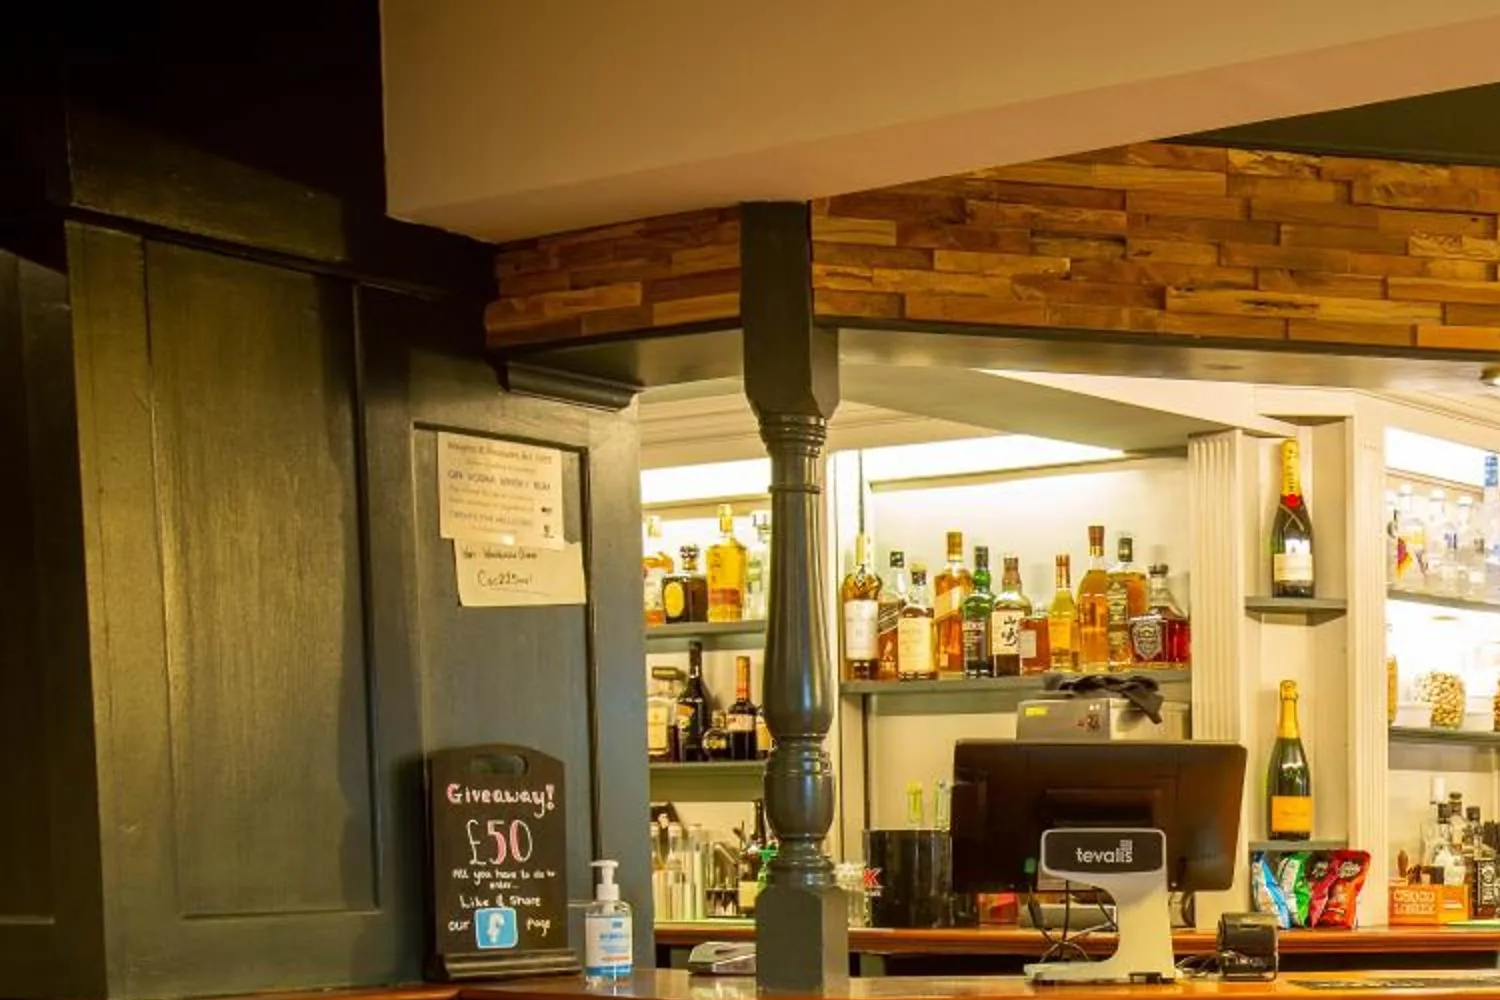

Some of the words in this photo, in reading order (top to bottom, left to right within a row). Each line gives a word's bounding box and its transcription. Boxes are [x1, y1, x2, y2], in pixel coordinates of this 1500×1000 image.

[447, 783, 555, 818] Giveaway!
[466, 819, 533, 865] £50
[1075, 845, 1133, 864] tevalis
[473, 870, 492, 886] you
[495, 868, 518, 879] have
[521, 868, 531, 880] to
[459, 894, 489, 909] Like
[447, 919, 471, 932] our
